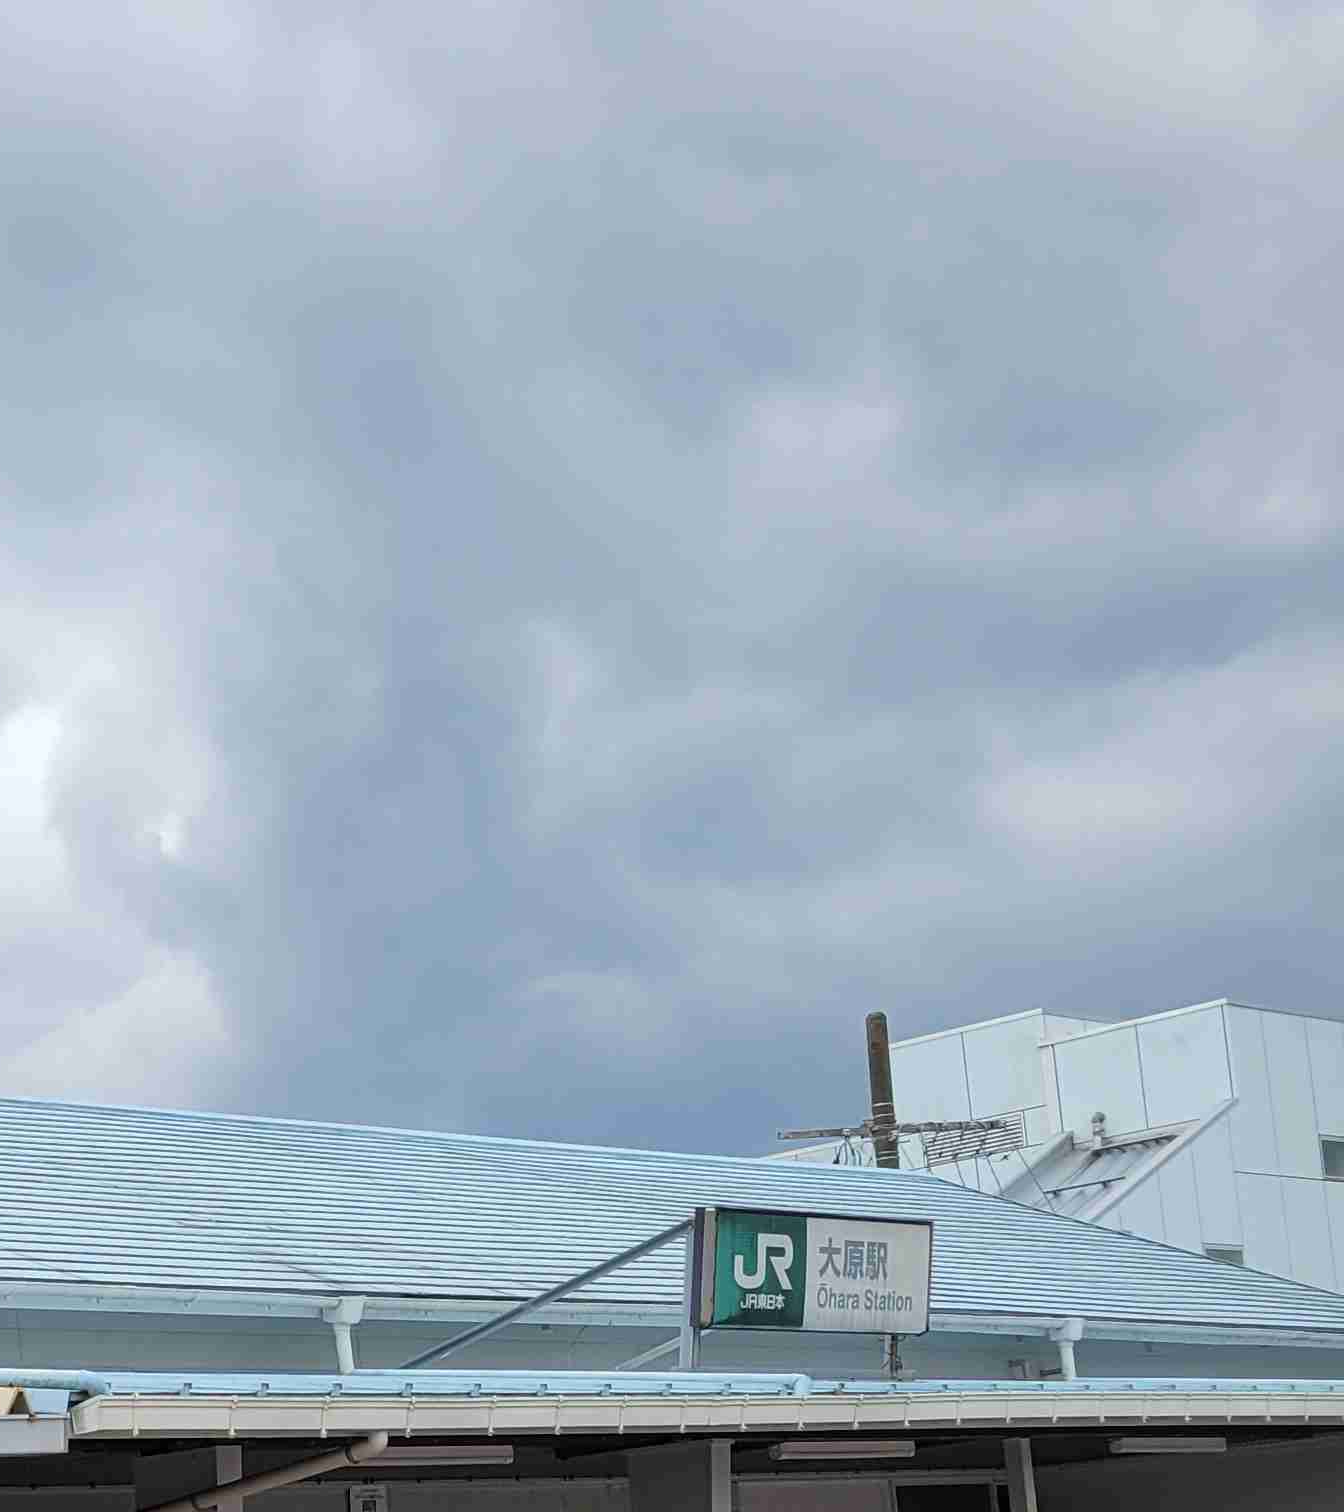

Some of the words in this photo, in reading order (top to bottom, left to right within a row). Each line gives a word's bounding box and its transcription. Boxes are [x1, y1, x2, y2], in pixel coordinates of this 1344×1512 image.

[733, 1232, 794, 1290] JR
[818, 1237, 888, 1281] 大原駅
[740, 1292, 786, 1310] JR東日本
[863, 1288, 913, 1312] Station
